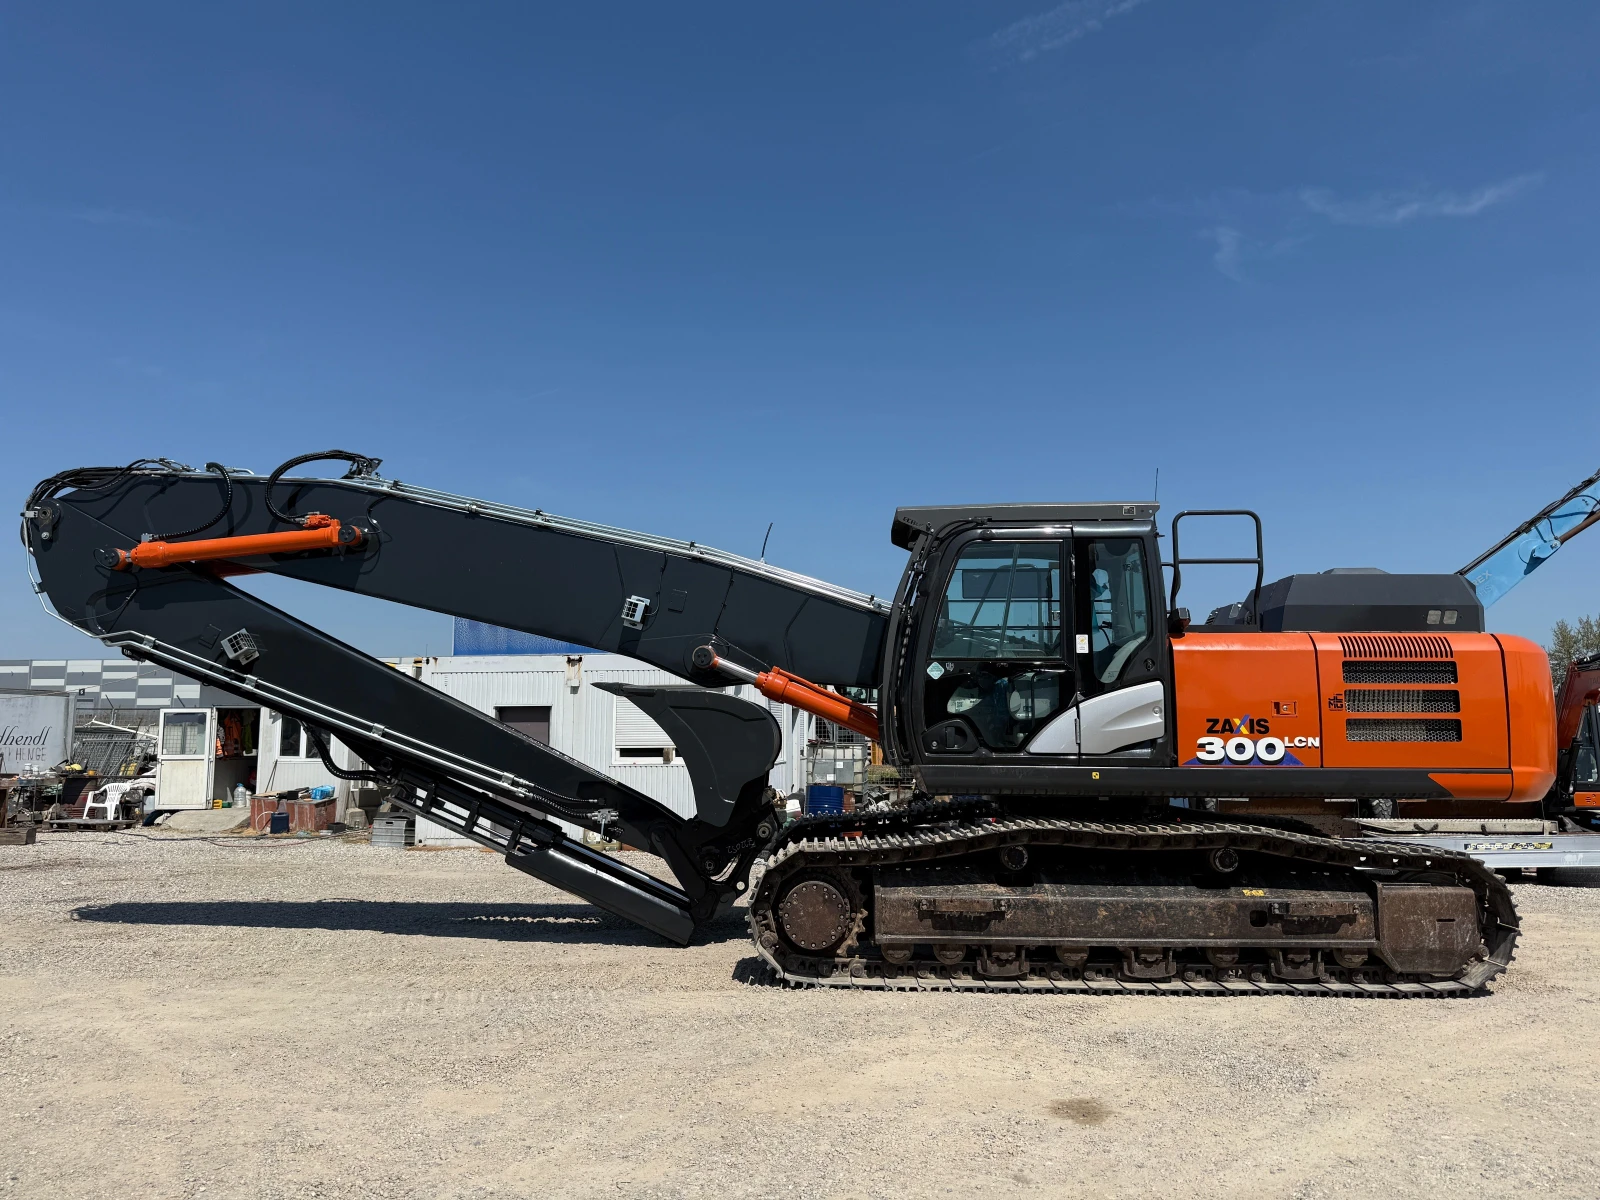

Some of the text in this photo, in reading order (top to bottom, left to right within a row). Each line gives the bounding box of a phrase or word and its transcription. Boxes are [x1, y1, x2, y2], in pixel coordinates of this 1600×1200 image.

[1206, 714, 1269, 734] ZAXIS
[1196, 737, 1319, 765] 300 LCN
